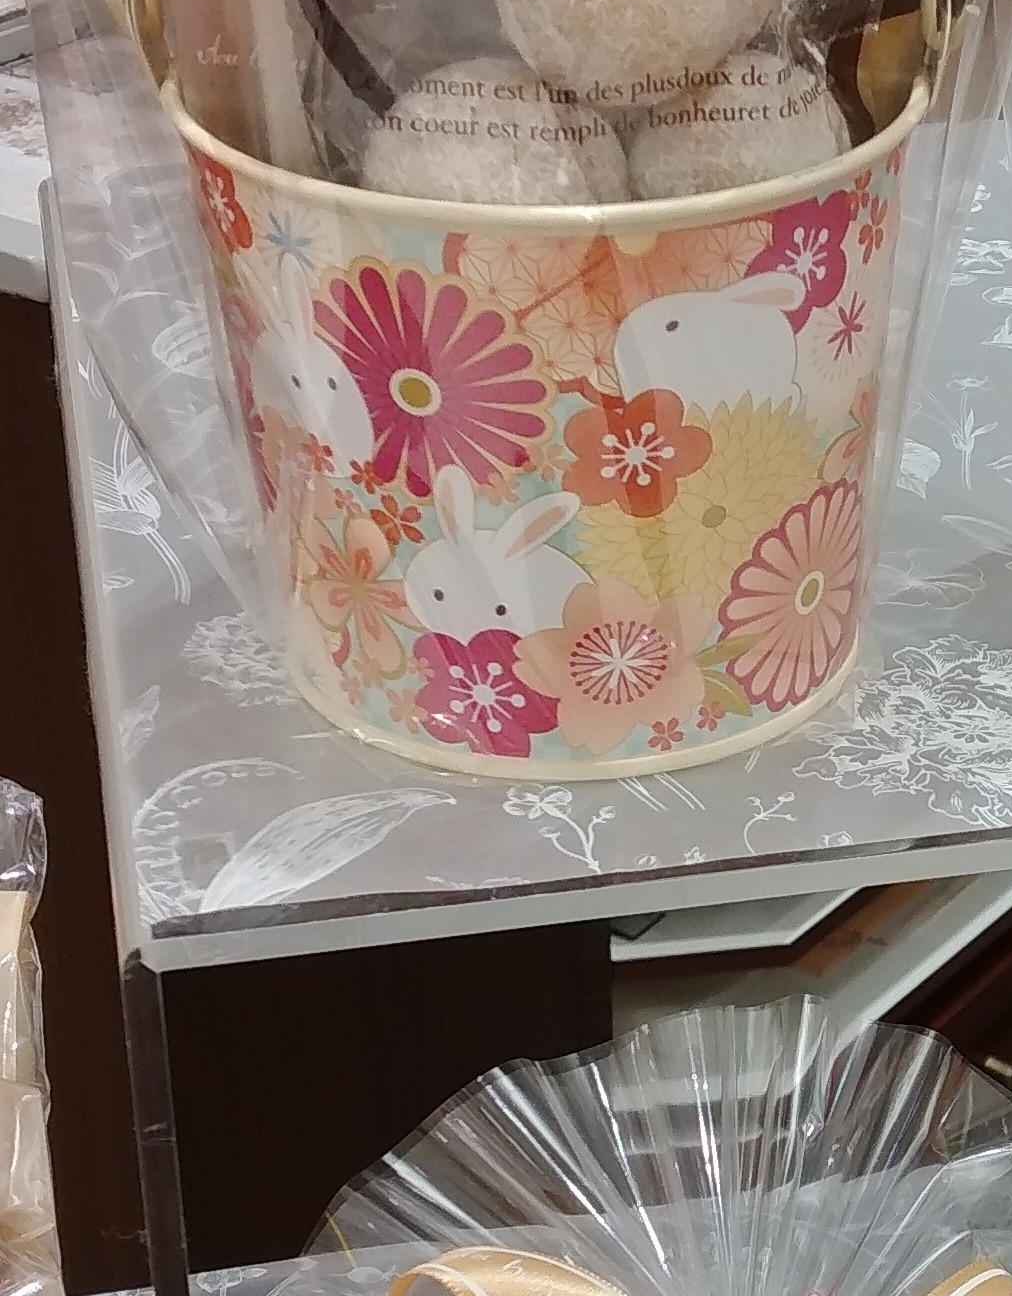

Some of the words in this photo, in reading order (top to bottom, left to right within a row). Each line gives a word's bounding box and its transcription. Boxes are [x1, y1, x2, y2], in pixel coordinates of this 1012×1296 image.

[409, 77, 485, 100] oment
[494, 81, 527, 102] est
[585, 79, 624, 104] des
[741, 63, 769, 87] de
[410, 115, 479, 137] coeur
[487, 119, 520, 140] est
